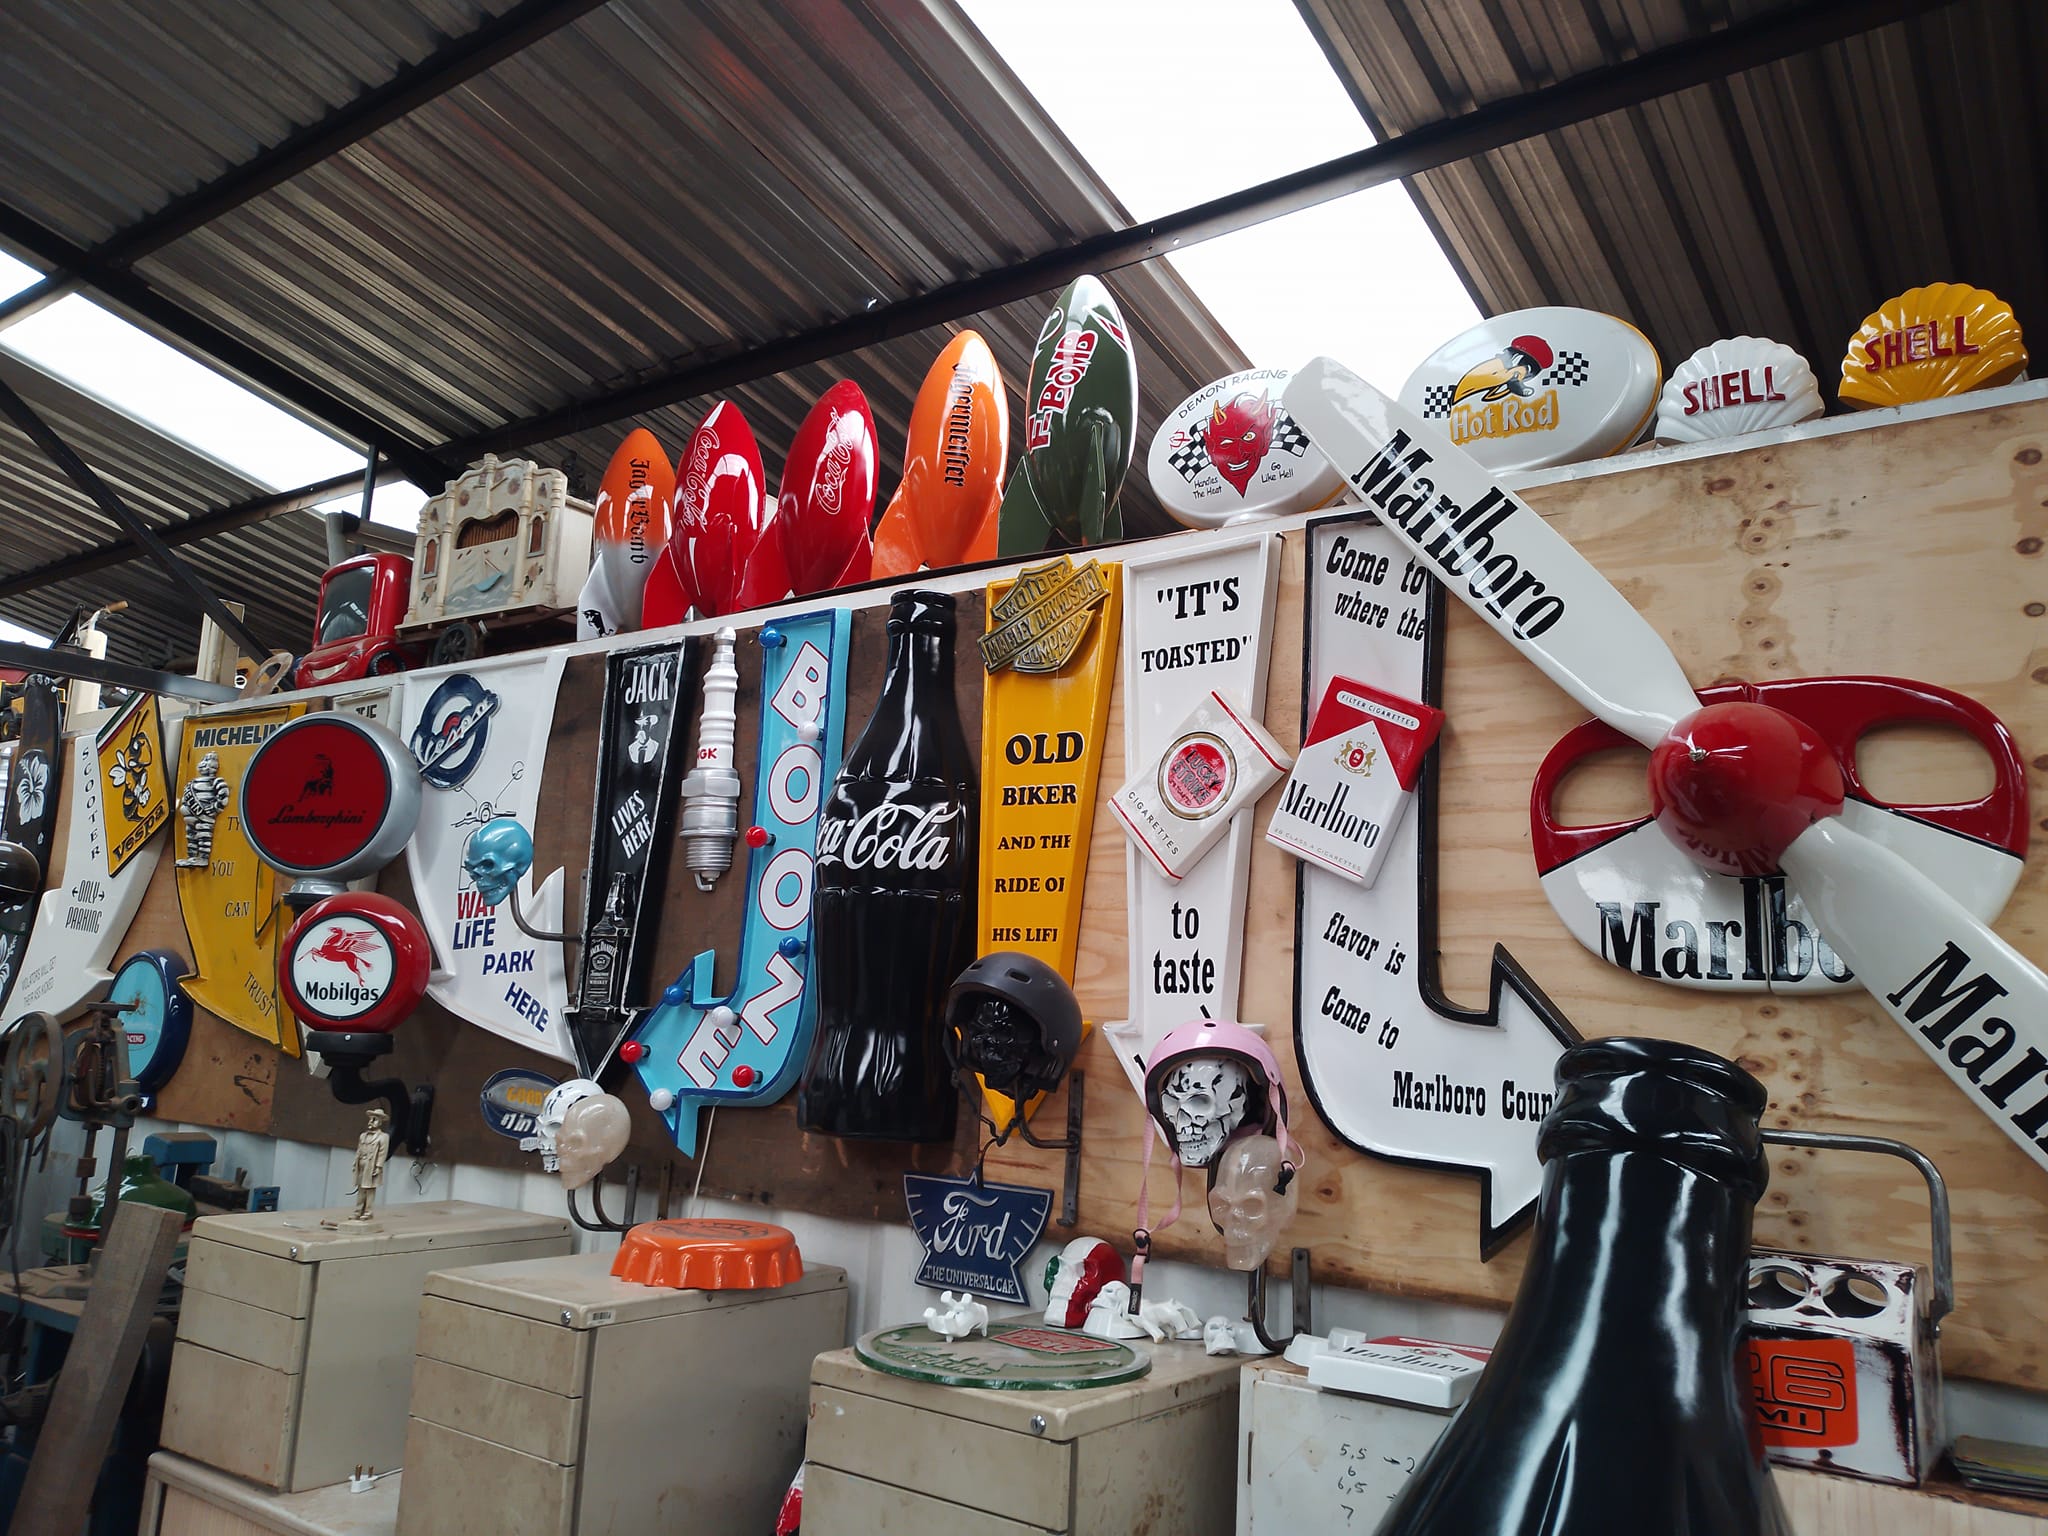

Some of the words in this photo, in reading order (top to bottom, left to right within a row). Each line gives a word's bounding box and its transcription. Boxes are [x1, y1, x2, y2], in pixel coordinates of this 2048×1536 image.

[1864, 314, 1982, 373] SHELL
[1178, 380, 1227, 420] DEMON
[1231, 369, 1289, 385] RACING
[1682, 366, 1787, 416] SHELL
[1452, 407, 1496, 441] Hot
[1502, 393, 1553, 432] Rod
[682, 426, 720, 533] Coca-Cola
[1261, 473, 1277, 483] Like
[1279, 469, 1294, 481] Hell
[1270, 462, 1282, 472] Go
[1193, 490, 1206, 499] The
[1206, 486, 1222, 498] Heat
[1350, 428, 1565, 641] Marlboro
[1326, 535, 1389, 587] Come
[1400, 555, 1427, 595] to
[1157, 577, 1240, 620] "IT'S
[1333, 590, 1389, 630] where
[1397, 605, 1425, 642] the
[1141, 634, 1253, 673] TOASTED"
[625, 660, 672, 705] JACK
[1341, 693, 1367, 709] FILTER
[1368, 704, 1415, 727] CIGARETTES
[414, 697, 496, 772] Vespa
[696, 747, 718, 760] GK
[1005, 731, 1084, 765] OLD
[1172, 759, 1211, 805] STRIKE
[1185, 749, 1221, 789] LUCKY
[82, 746, 101, 861] SCOOTER
[611, 789, 646, 837] LIVES
[1001, 783, 1077, 806] BIKER
[1279, 778, 1381, 849] Marlboro
[113, 804, 165, 862] Vespa
[267, 804, 367, 828] Lamborghini
[1127, 791, 1180, 856] CIGARETTES
[997, 836, 1037, 850] AND
[211, 859, 235, 877] YOU
[994, 877, 1041, 893] RIDE
[77, 879, 101, 904] ONLY
[225, 901, 250, 917] CAN
[65, 906, 103, 934] PARKING
[453, 917, 496, 950] LIFE
[992, 928, 1021, 942] HIS
[1171, 900, 1200, 940] to
[482, 950, 535, 976] PARK
[1323, 911, 1380, 963] flavor
[1384, 941, 1407, 976] is
[1153, 948, 1215, 995] taste
[244, 971, 275, 1018] TRUST
[305, 981, 379, 1006] Mobilgas
[504, 981, 550, 1033] HERE
[1321, 985, 1372, 1036] Come
[1378, 1016, 1401, 1051] to
[506, 1086, 550, 1106] GOOD
[1392, 1070, 1487, 1117] Marlboro
[1502, 1079, 1559, 1122] Coun
[933, 1191, 1010, 1260] Ford
[924, 1265, 945, 1282] THE
[946, 1268, 996, 1291] UNIVERSAL
[995, 1277, 1016, 1294] CAR
[1347, 1465, 1357, 1477] 6
[1340, 1504, 1355, 1520] 7
